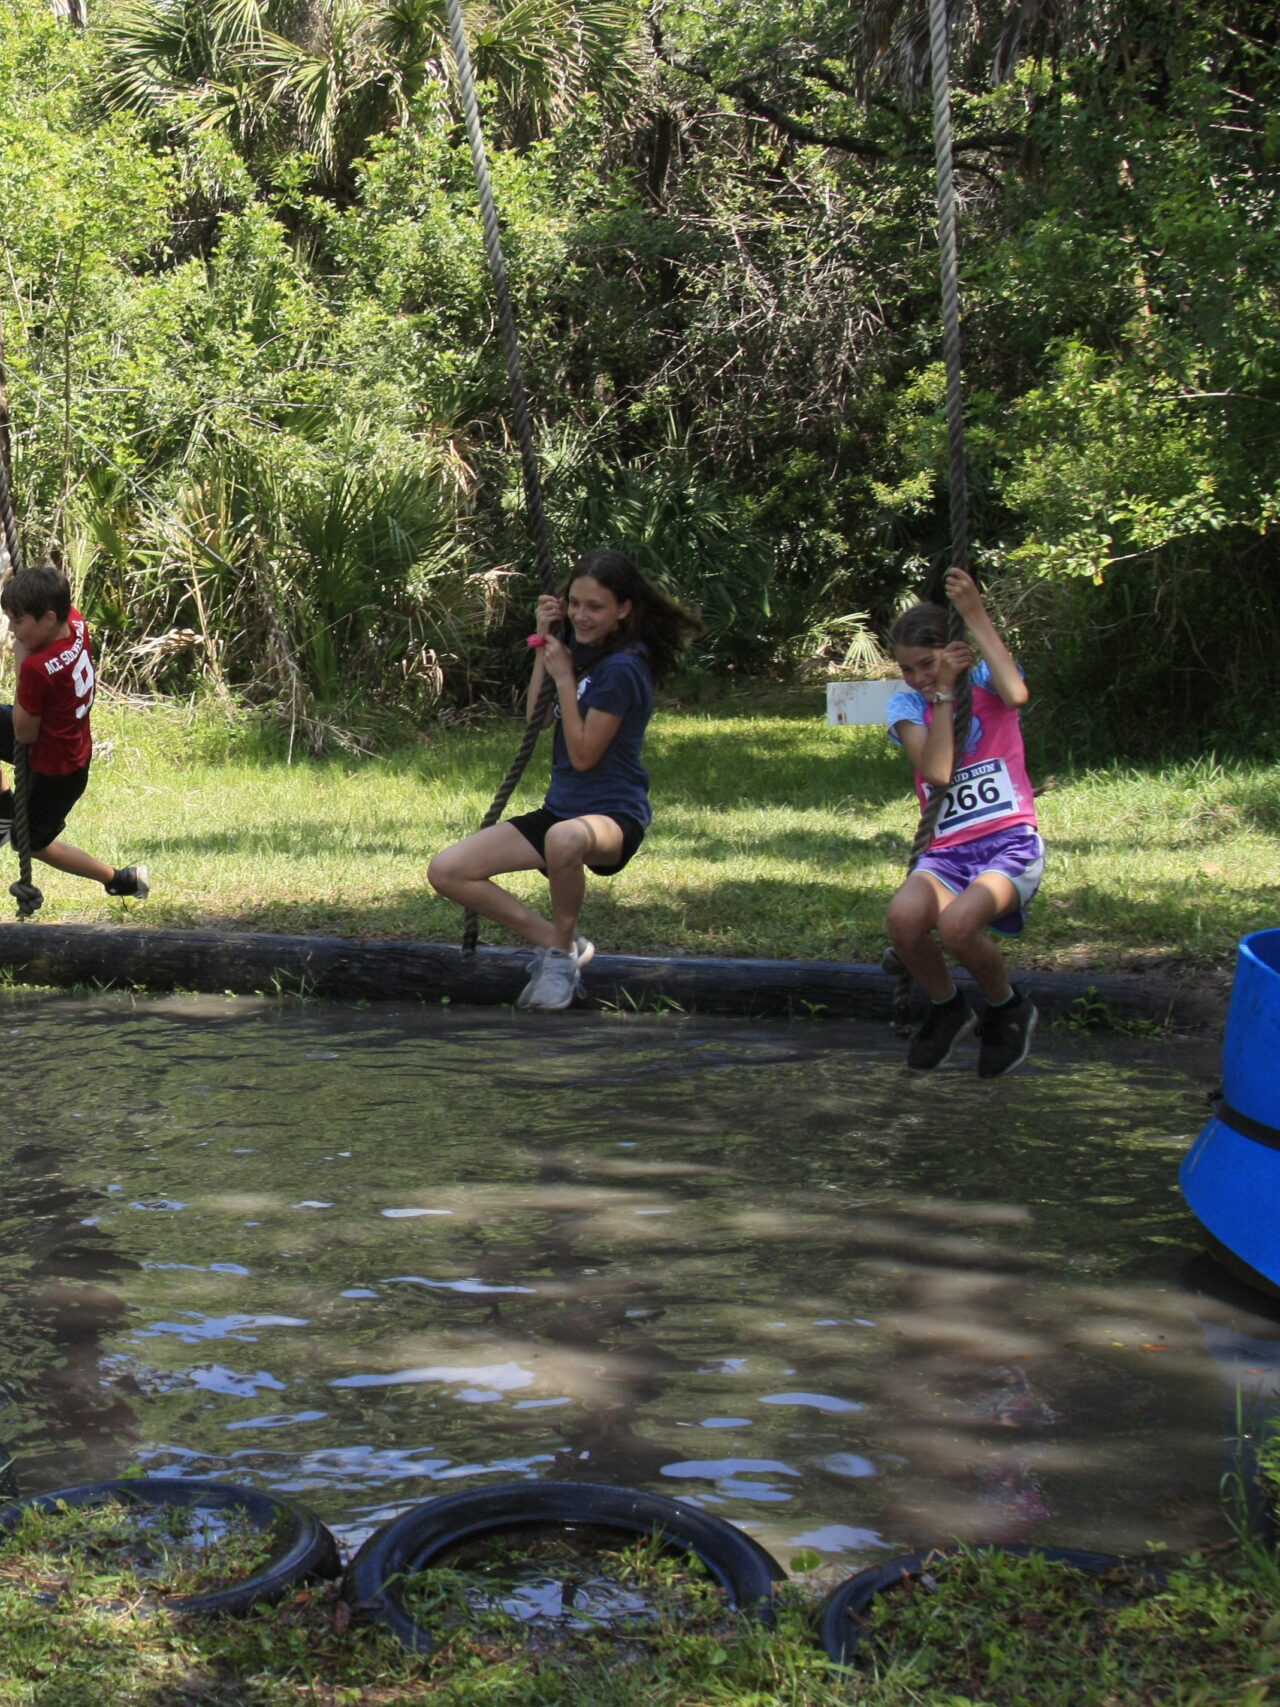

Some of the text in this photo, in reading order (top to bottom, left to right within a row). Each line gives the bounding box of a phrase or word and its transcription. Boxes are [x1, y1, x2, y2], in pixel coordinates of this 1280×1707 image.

[44, 657, 64, 675] ACE
[72, 649, 94, 719] 9
[952, 763, 995, 784] UD RUN
[944, 777, 1000, 819] 266
